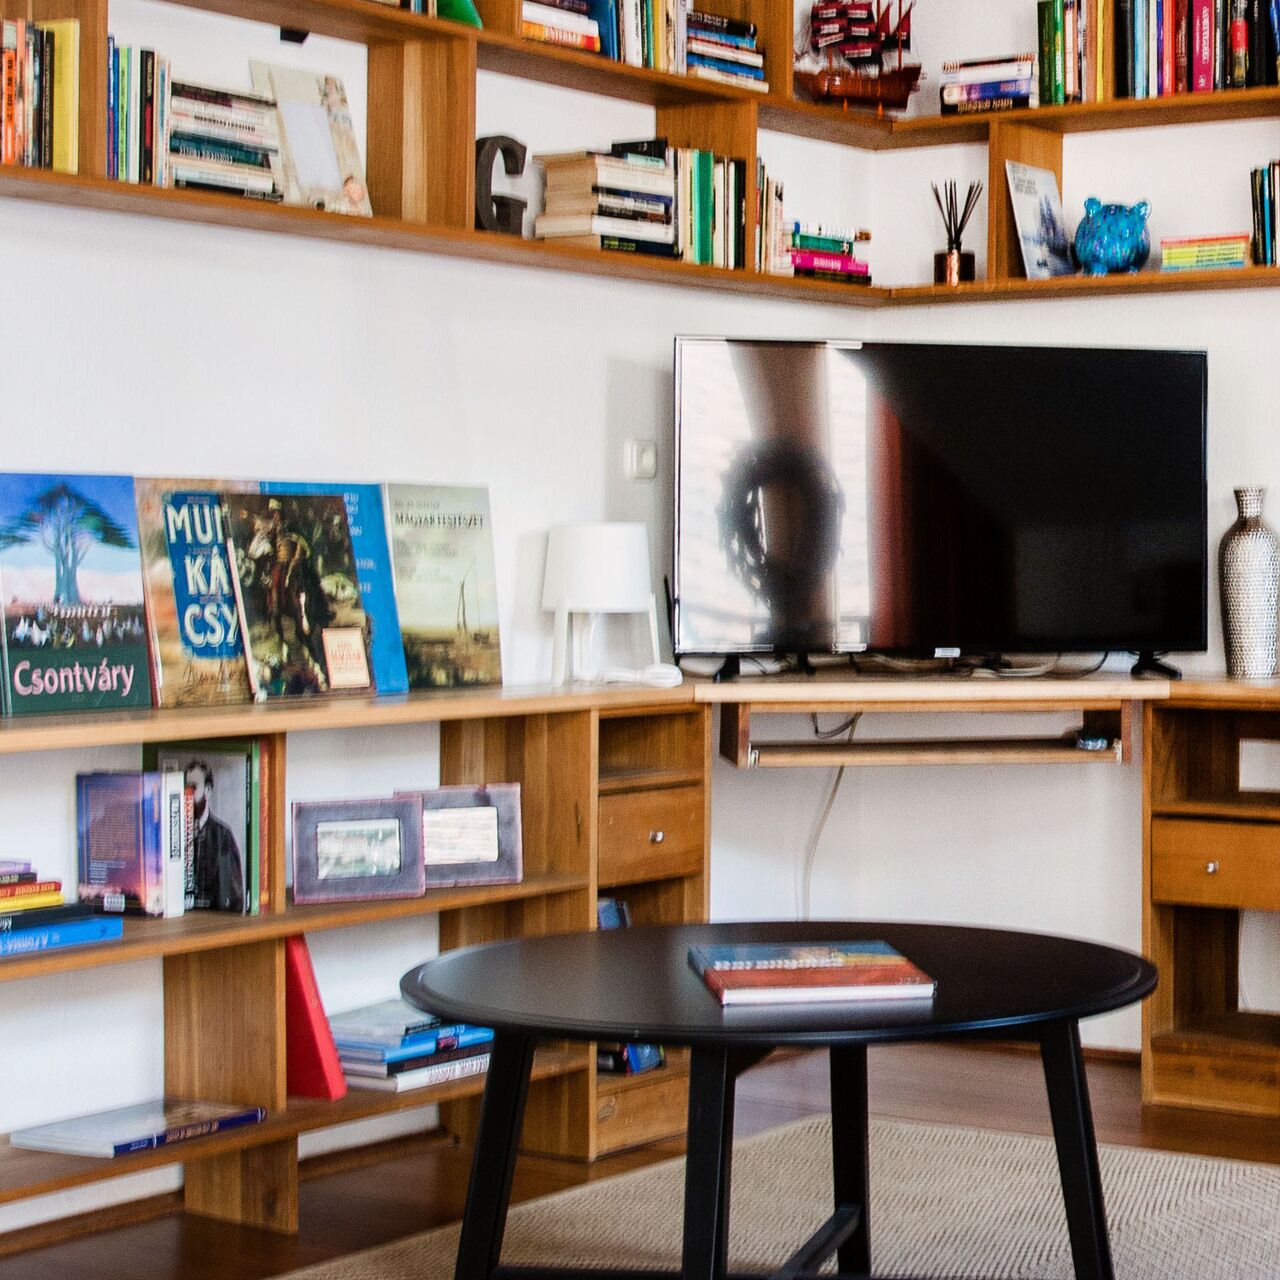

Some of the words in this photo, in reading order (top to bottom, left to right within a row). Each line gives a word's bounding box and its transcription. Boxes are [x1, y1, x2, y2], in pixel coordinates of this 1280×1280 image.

[475, 135, 527, 237] G
[184, 602, 239, 648] CSY
[13, 657, 135, 697] Csontváry
